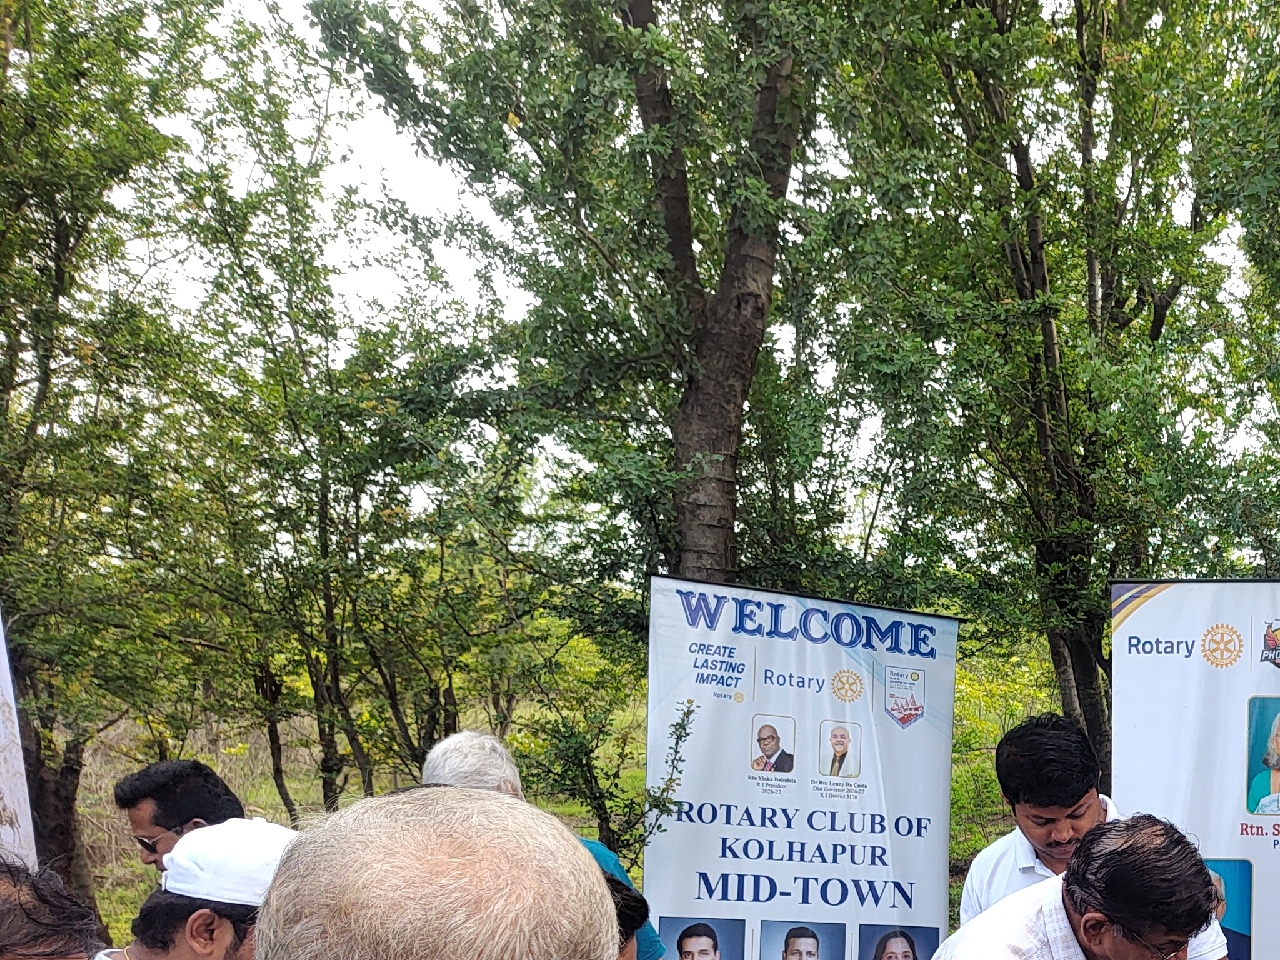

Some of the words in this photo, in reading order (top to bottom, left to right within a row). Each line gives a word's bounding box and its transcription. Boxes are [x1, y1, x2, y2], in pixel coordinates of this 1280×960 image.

[676, 589, 937, 660] WELCOME
[688, 642, 737, 658] CREATE
[1127, 635, 1196, 659] Rotary
[693, 658, 746, 674] LASTING
[695, 673, 742, 688] IMPACT
[763, 669, 825, 694] Rotary
[713, 692, 732, 700] Rotary
[676, 801, 799, 830] ROTARY
[807, 809, 886, 834] CLUB
[894, 816, 931, 838] OF
[1239, 823, 1268, 836] Rtn.
[719, 836, 889, 867] KOLHAPUR
[695, 871, 916, 909] MID-TOWN
